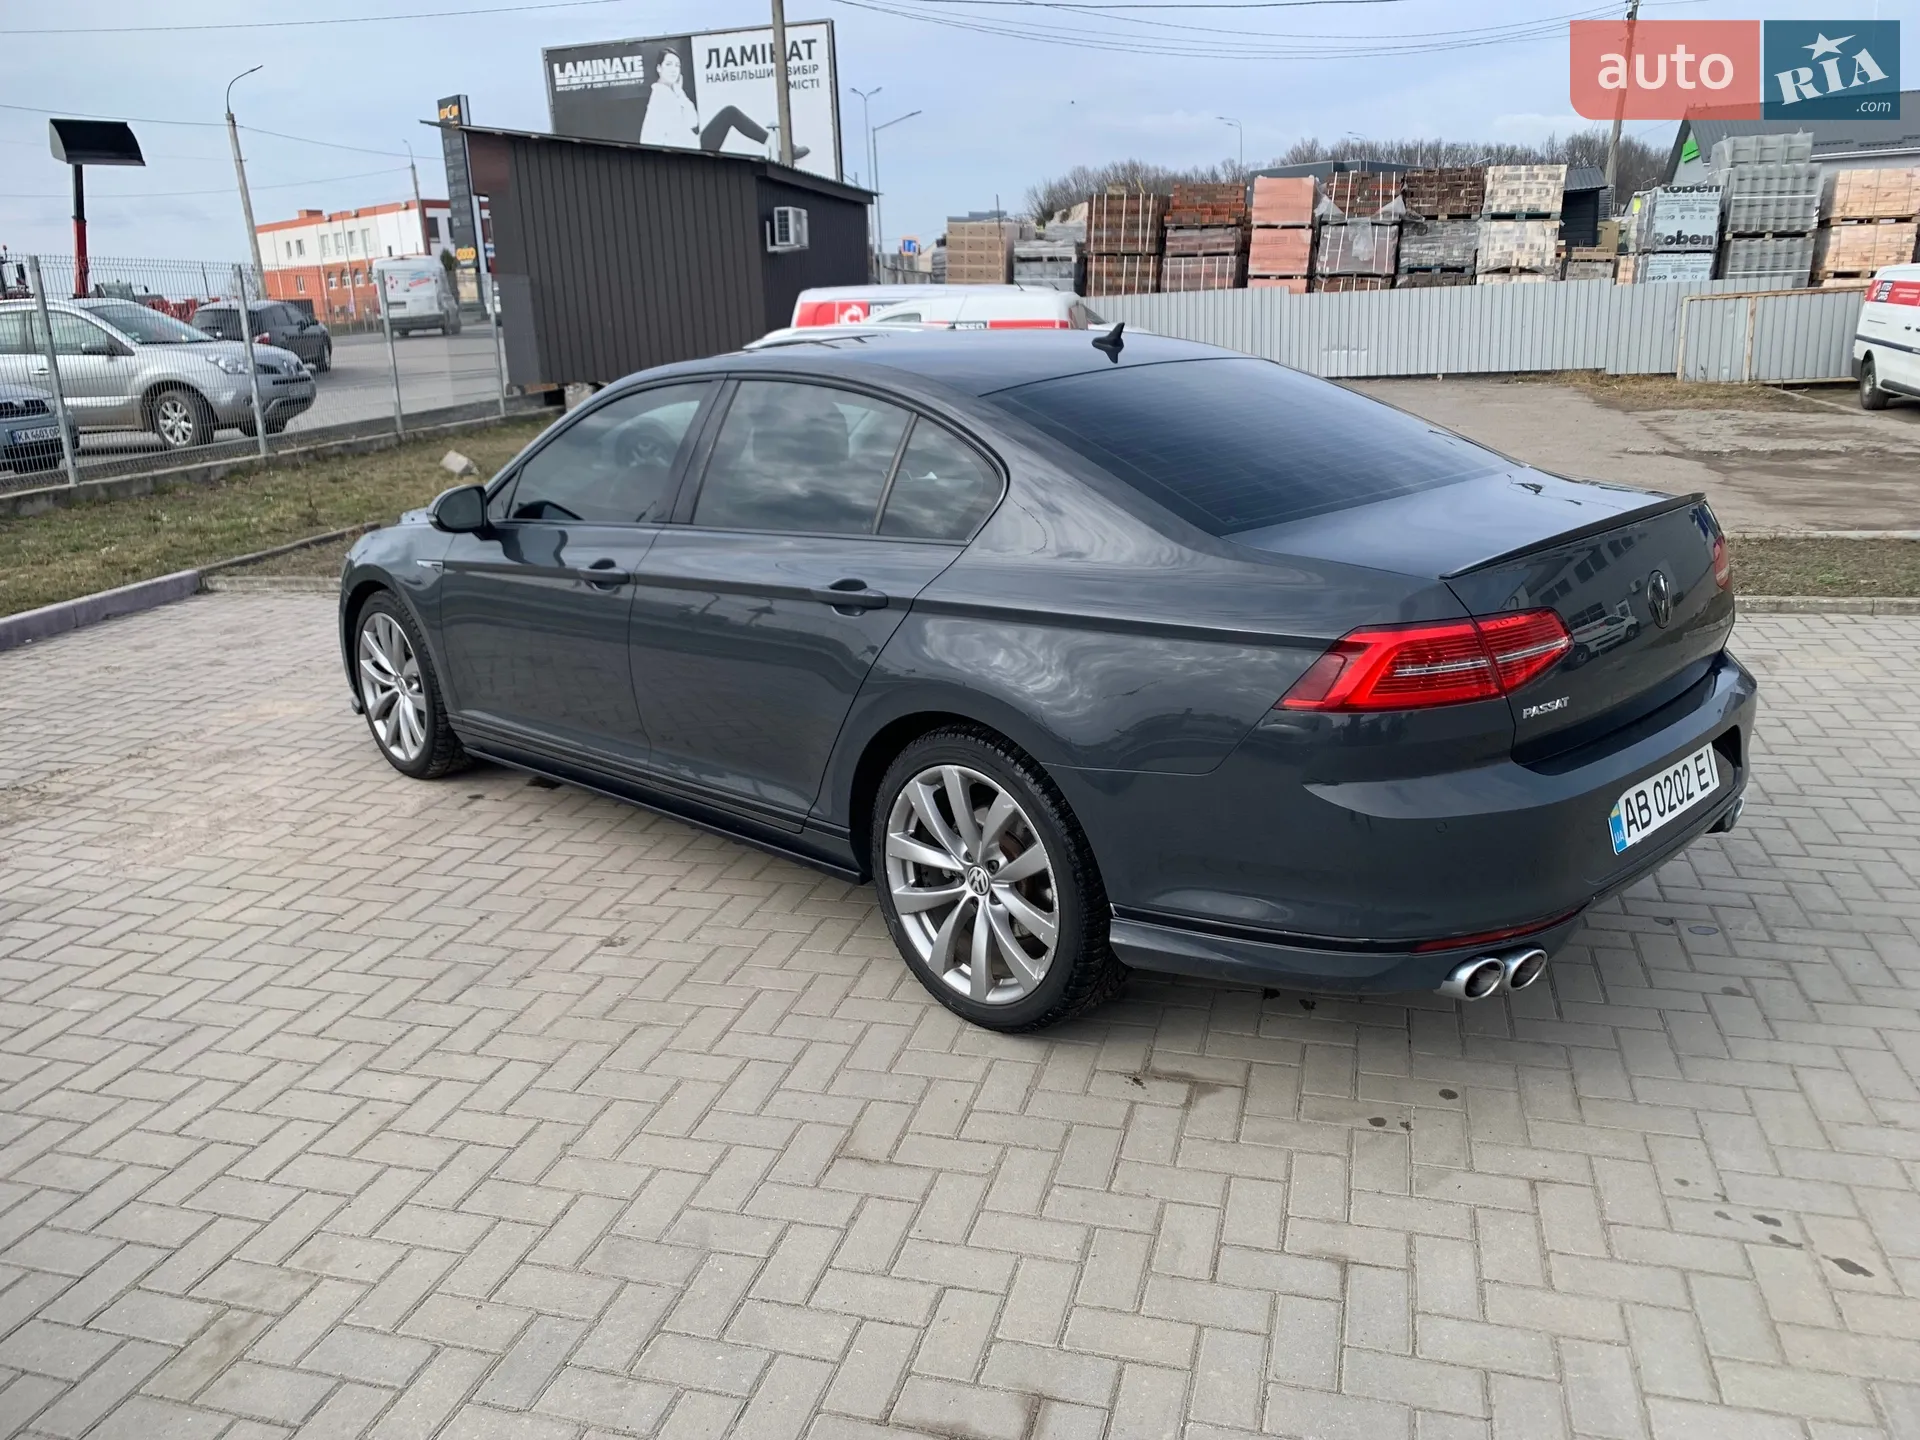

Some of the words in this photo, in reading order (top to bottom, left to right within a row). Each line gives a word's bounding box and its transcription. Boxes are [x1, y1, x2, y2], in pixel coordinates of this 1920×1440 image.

[553, 55, 644, 79] LAMINATE
[706, 67, 775, 83] НАЙБІЛЬШИ
[1522, 696, 1570, 719] PASSAT
[1625, 789, 1652, 838] AB
[1653, 764, 1695, 818] 0202
[1694, 749, 1715, 792] EI
[1614, 829, 1625, 844] UA
